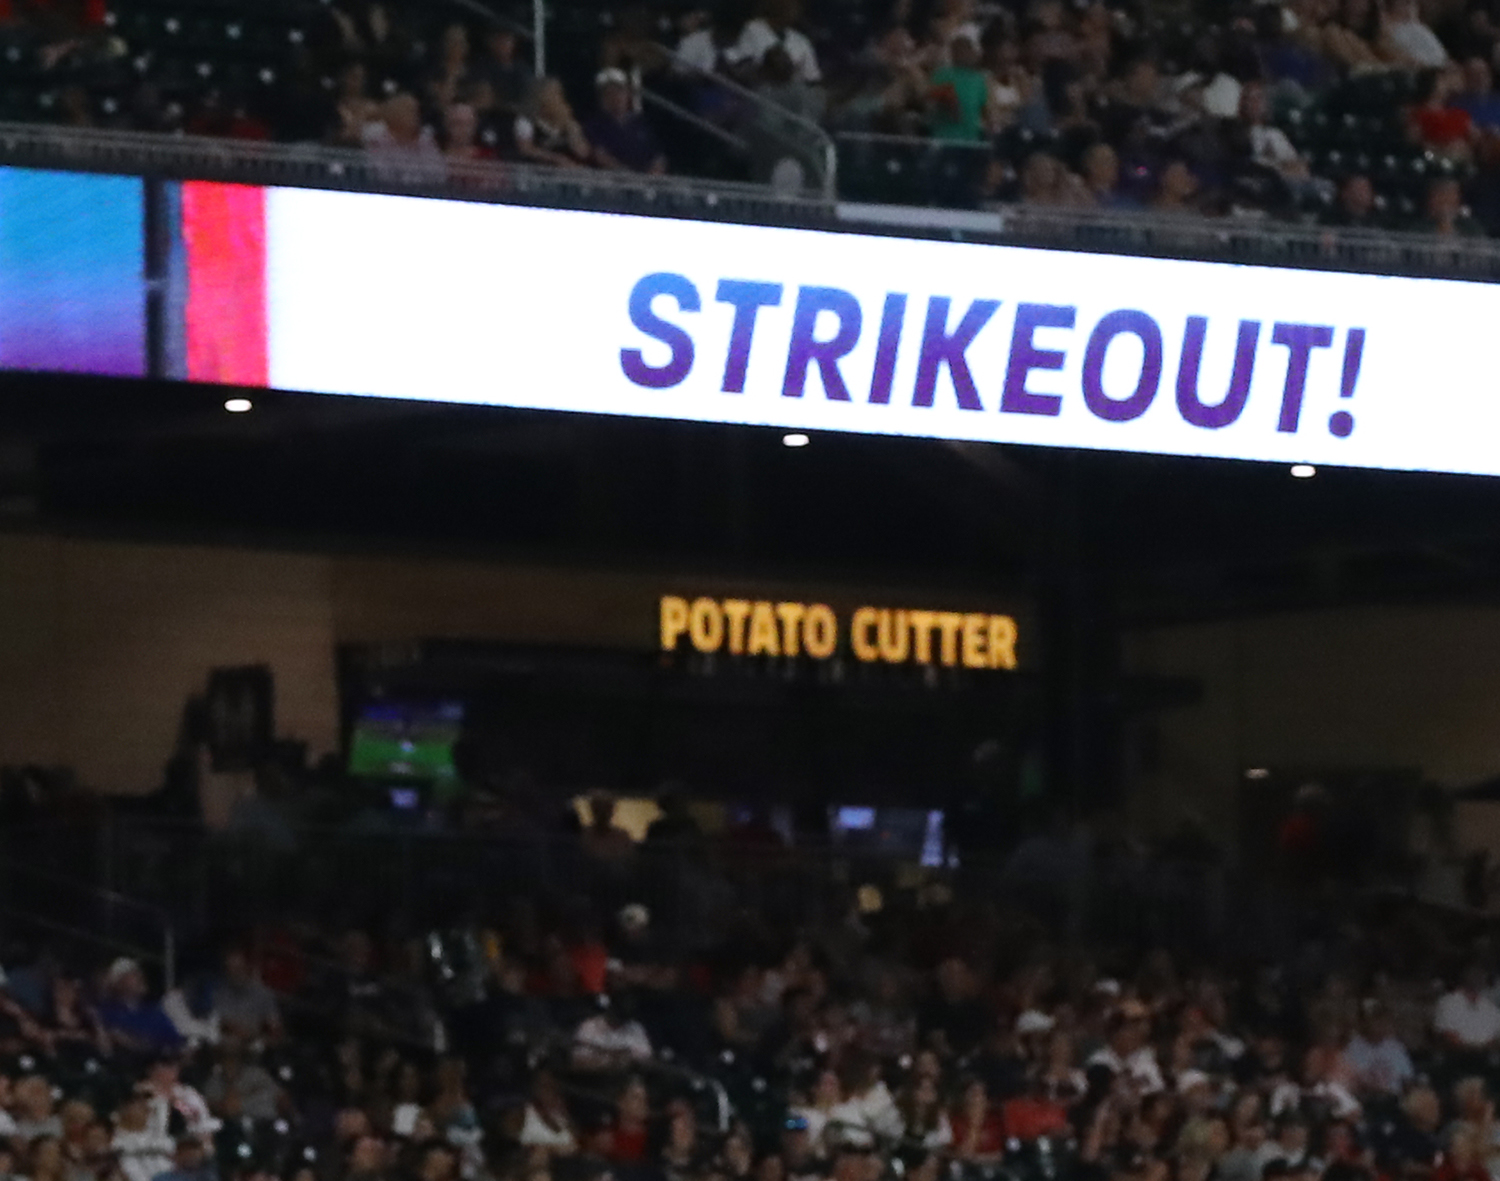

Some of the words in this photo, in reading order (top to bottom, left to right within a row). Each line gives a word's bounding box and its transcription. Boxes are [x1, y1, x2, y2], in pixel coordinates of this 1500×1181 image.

[620, 271, 1366, 439] STRIKEOUT!
[660, 596, 837, 659] POTATO
[851, 606, 1018, 669] CUTTER
